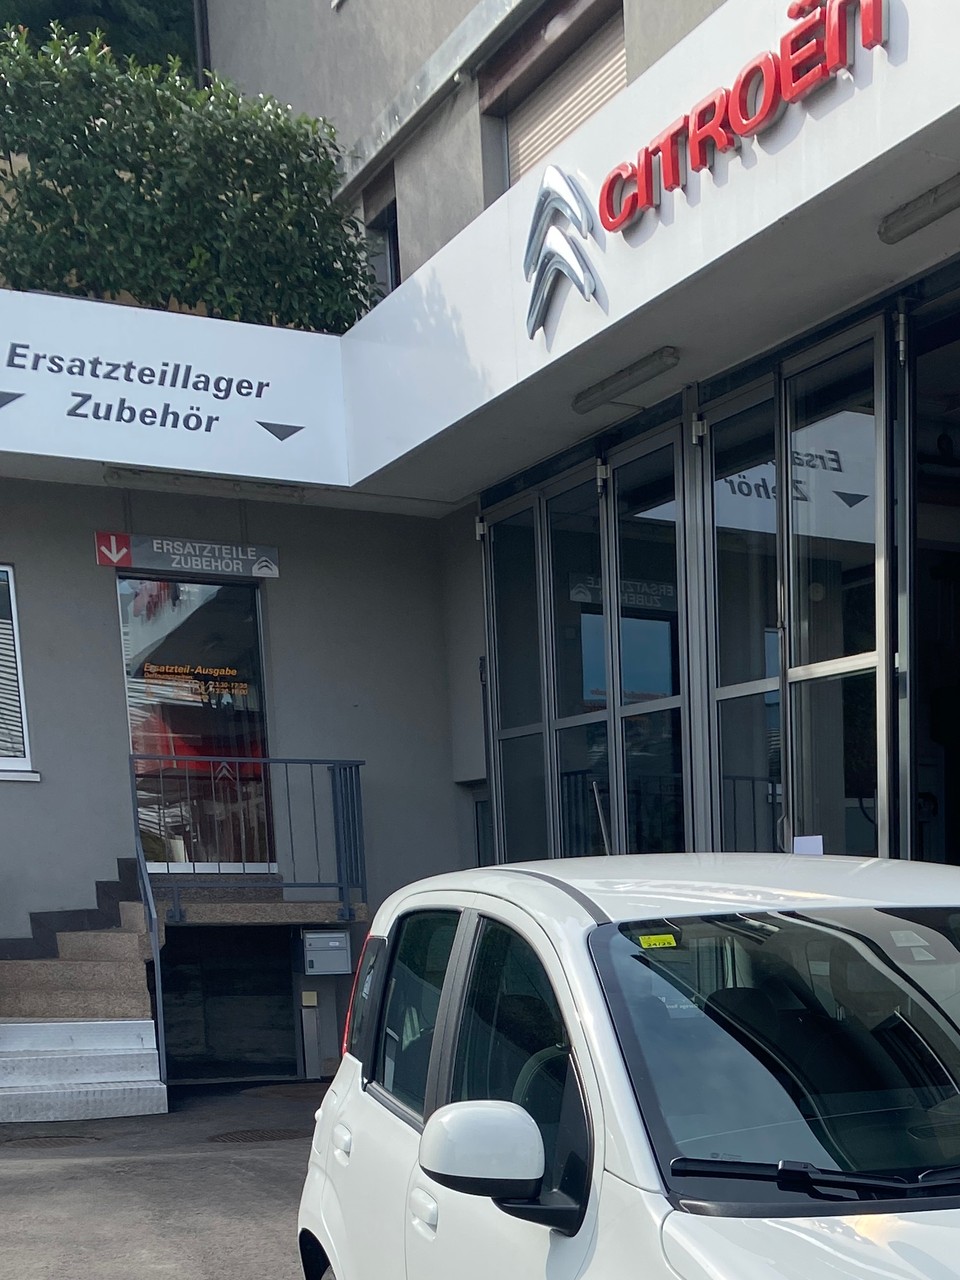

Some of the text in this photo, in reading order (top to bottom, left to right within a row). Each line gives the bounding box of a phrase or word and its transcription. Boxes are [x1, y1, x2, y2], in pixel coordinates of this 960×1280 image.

[599, 0, 886, 233] CITROËN
[5, 341, 270, 400] Ersatzteillager
[66, 391, 220, 433] Zubehör
[152, 539, 257, 561] ERSATZTEILE
[171, 553, 243, 573] ZUBEHÖR
